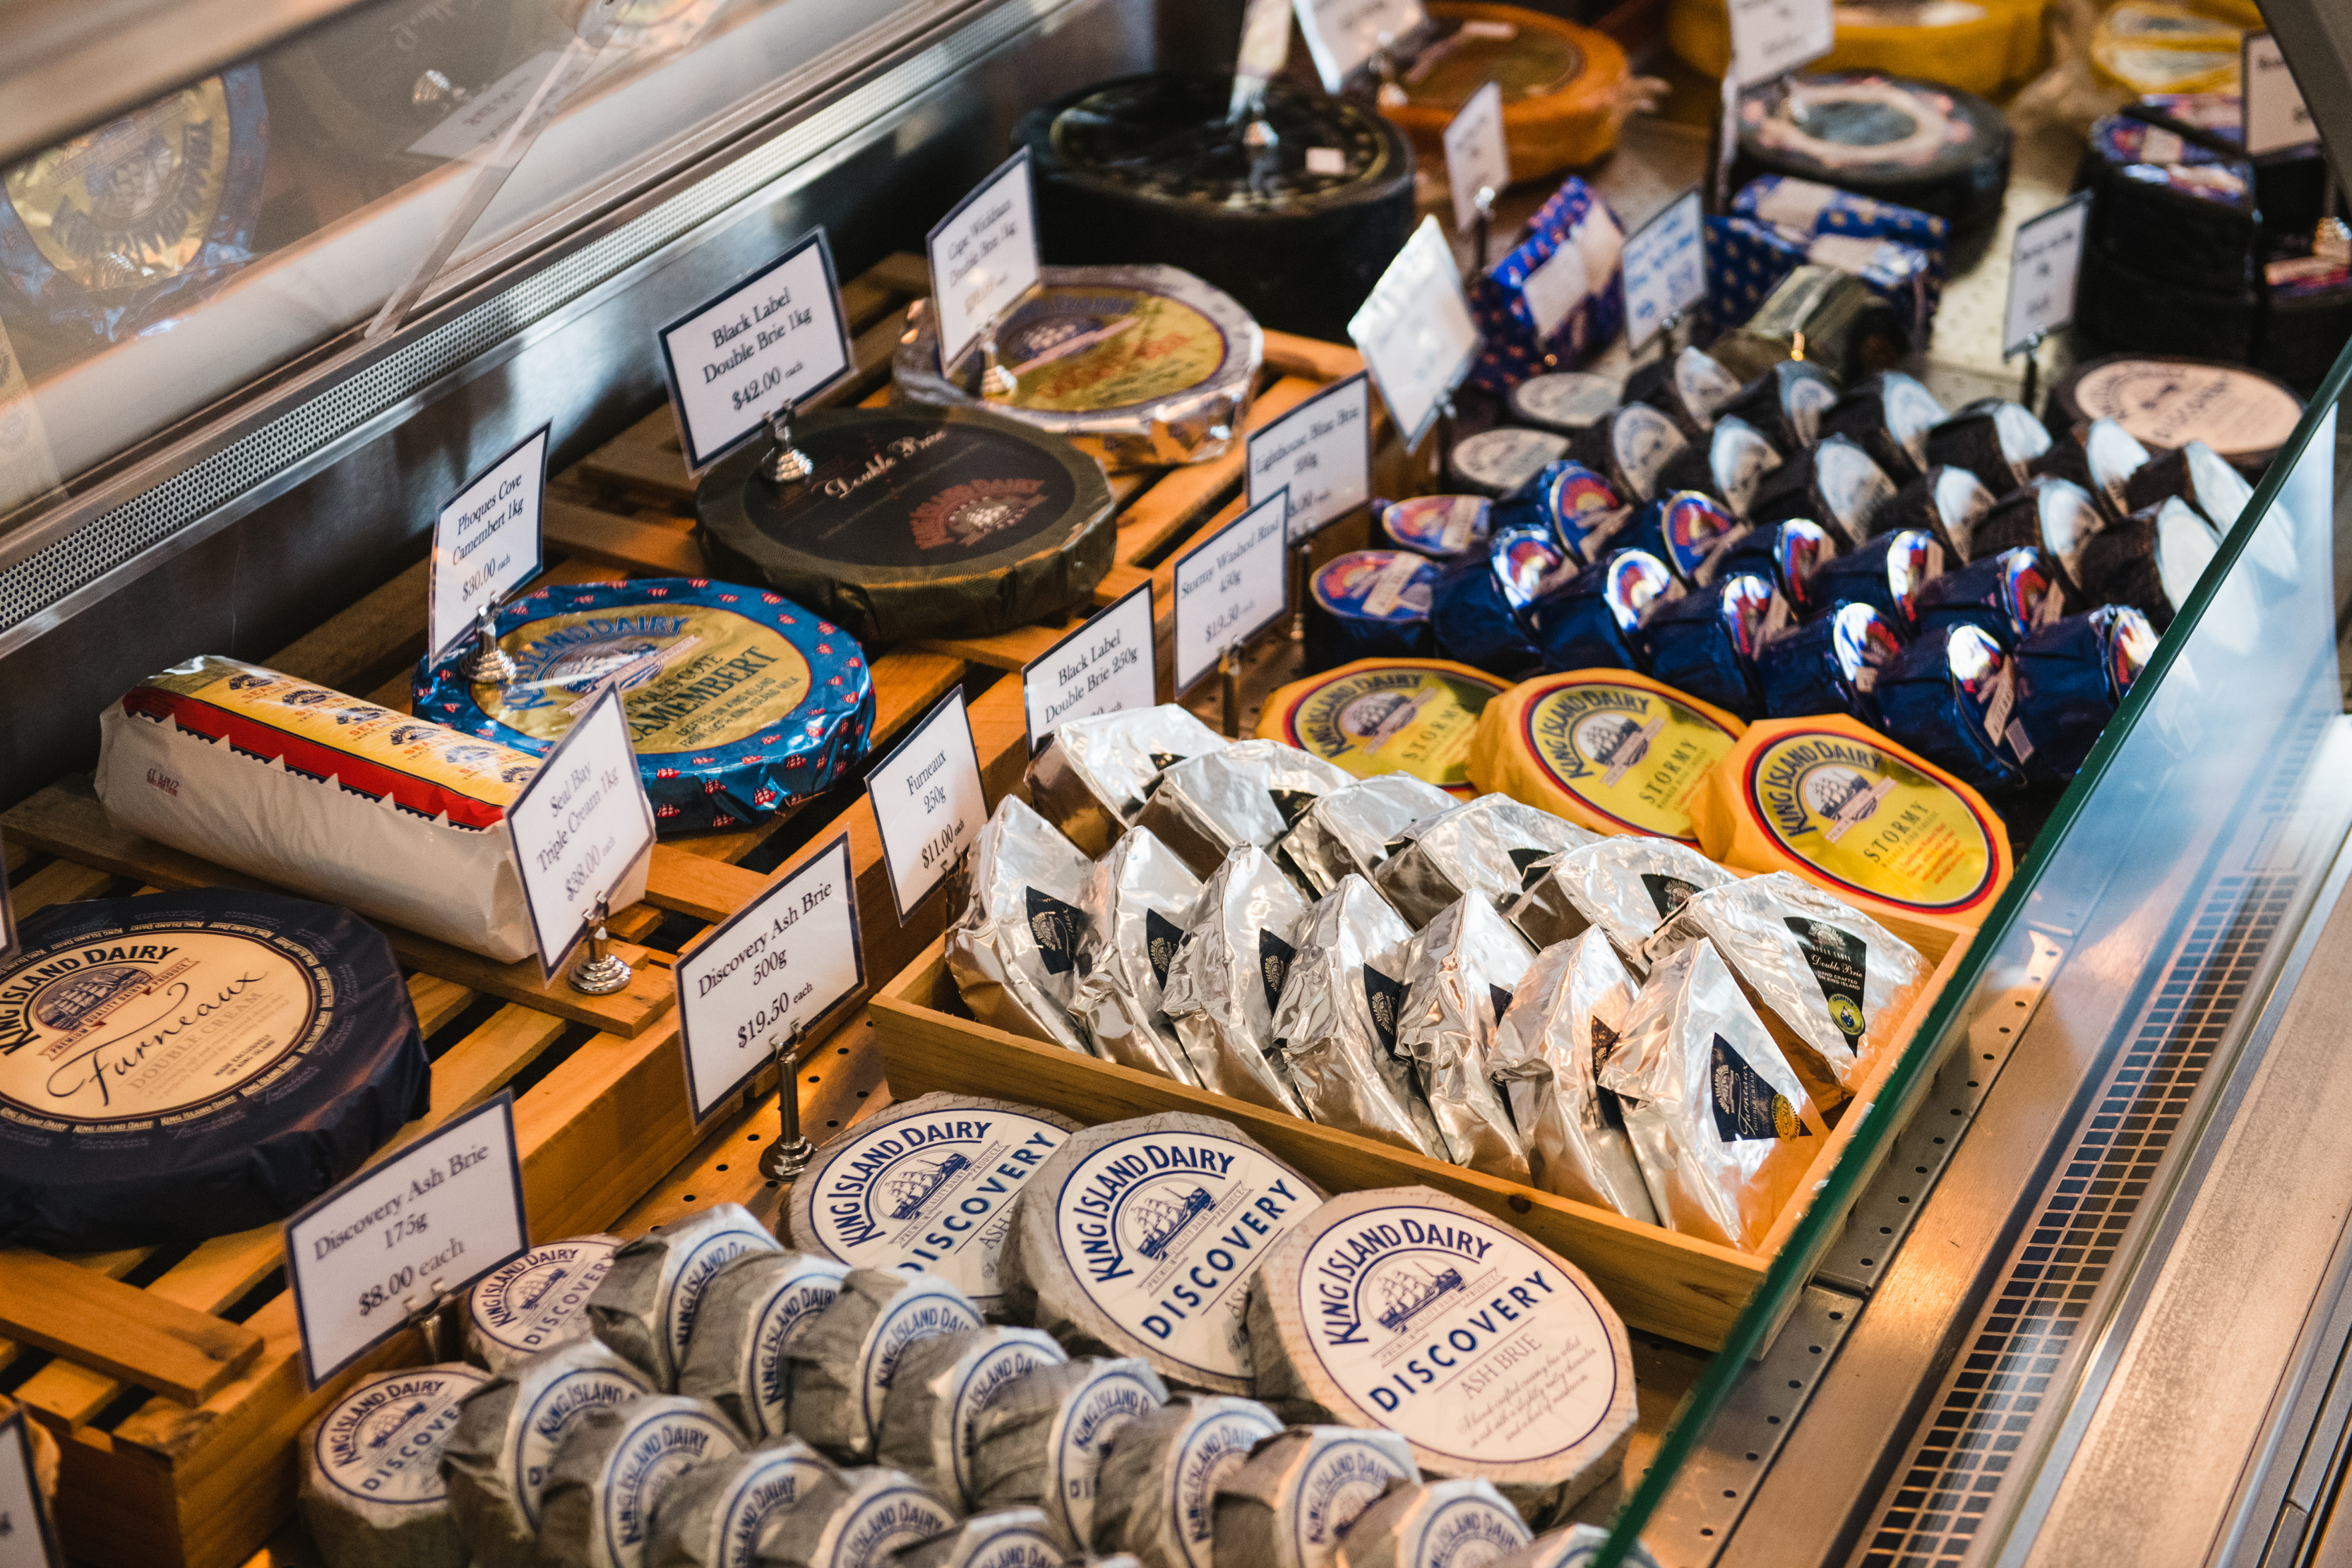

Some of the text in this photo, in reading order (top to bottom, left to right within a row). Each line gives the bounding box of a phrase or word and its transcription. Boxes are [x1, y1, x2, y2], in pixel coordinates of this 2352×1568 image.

[703, 306, 813, 385] Double Brie 1kg
[712, 287, 792, 349] Black Label
[732, 361, 804, 412] $42.00 each
[452, 497, 525, 567] Camembert 1kg
[458, 474, 523, 537] Phoques Cove
[462, 553, 511, 602] $30.00 each
[586, 615, 690, 638] DAIRY
[1058, 628, 1121, 687] Black Label
[1045, 686, 1085, 725] Double
[1087, 666, 1110, 693] Brie
[1112, 647, 1138, 674] 250g
[1581, 689, 1651, 716] DAIRY
[679, 731, 706, 748] FROM
[906, 749, 948, 797] Furneaux
[1638, 738, 1698, 806] STORMY
[536, 766, 621, 874] Triple Cream 1kg
[550, 760, 592, 819] Seal Bay
[923, 784, 947, 815] 250g
[1762, 739, 1882, 839] KING ISLAND DAIRY
[921, 818, 965, 870] $11.00 each
[1863, 800, 1930, 864] STORMY
[564, 842, 602, 902] $38.00
[698, 880, 833, 1000] Discovery Ash Brie
[752, 949, 788, 988] 500g
[1810, 953, 1863, 978] Double Brie
[0, 945, 180, 1057] KING ISLAND DAIRY
[51, 962, 189, 1055] PREMIUM QUALITY DAIRY PRODUCE
[1817, 969, 1858, 986] HAND CRAFTED
[1827, 976, 1840, 986] KING
[1840, 979, 1861, 991] ISLAND
[1831, 996, 1855, 1007] CHAMPION
[47, 969, 268, 1107] Furneaux
[129, 1034, 201, 1090] DOUBLE
[201, 991, 264, 1034] CREAM
[736, 981, 814, 1050] $19.50 each
[1714, 1071, 1723, 1098] ISLAND
[1735, 1062, 1757, 1136] Furneaux
[1781, 1100, 1790, 1137] GOLD
[313, 1143, 490, 1263] Discovery Ash Brie
[826, 1120, 993, 1248] KING ISLAND DAIRY
[899, 1146, 1001, 1243] PREMIUM QUALITY DAIRY PRODUCE
[1073, 1144, 1236, 1283] KING ISLAND DAIRY
[383, 1211, 429, 1250] 175g
[1142, 1178, 1299, 1340] DISCOVERY
[1147, 1188, 1245, 1289] PREMIUM QUALITY DAIRY PRODUCE
[358, 1236, 467, 1319] $8.00 each
[484, 1248, 580, 1329] KING ISLAND DAIRY
[676, 1248, 727, 1347] KING ISLAND
[1318, 1218, 1493, 1347] KING ISLAND DAIRY
[762, 1298, 799, 1406] KING ISLAND
[891, 1306, 939, 1351] ISLAND
[1369, 1270, 1555, 1413] DISCOVERY
[1459, 1332, 1543, 1401] ASH BRIE
[1520, 1366, 1548, 1390] creamy
[330, 1380, 445, 1468] KING ISLAND DAIRY
[616, 1425, 710, 1550] KING ISLAND DAIRY
[751, 1476, 796, 1509] DAIRY
